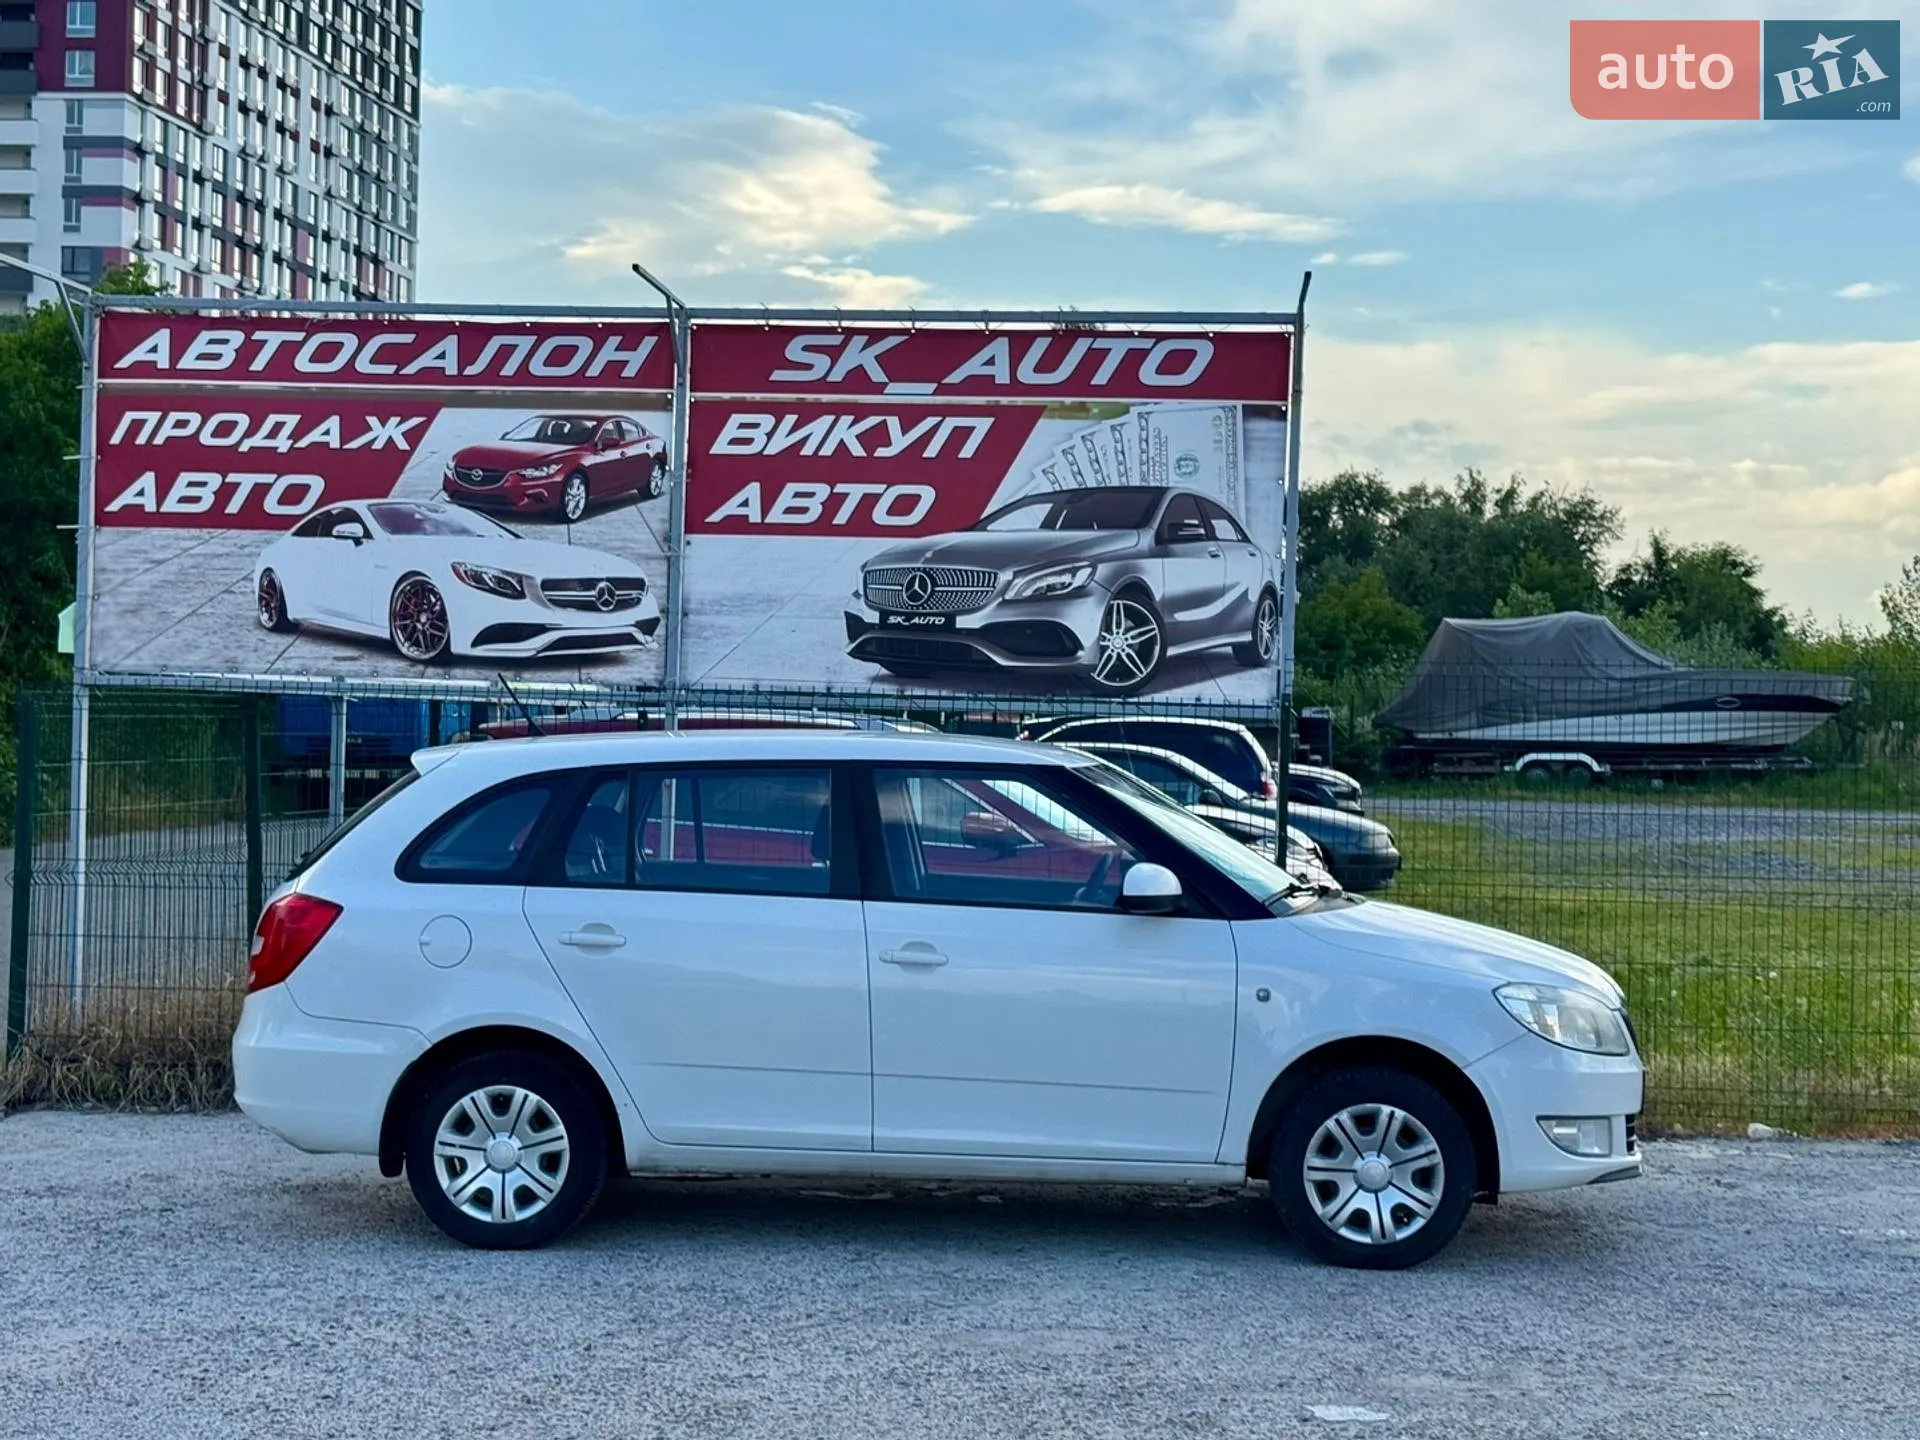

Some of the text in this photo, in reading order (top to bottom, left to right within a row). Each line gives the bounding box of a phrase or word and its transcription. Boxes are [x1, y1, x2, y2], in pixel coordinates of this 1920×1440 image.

[114, 328, 658, 377] АВТОСАЛОН
[108, 410, 427, 454] ПРОДАЖ
[709, 412, 996, 459] ВИКУП
[104, 471, 326, 515] АВТО
[704, 481, 937, 527] АВТО
